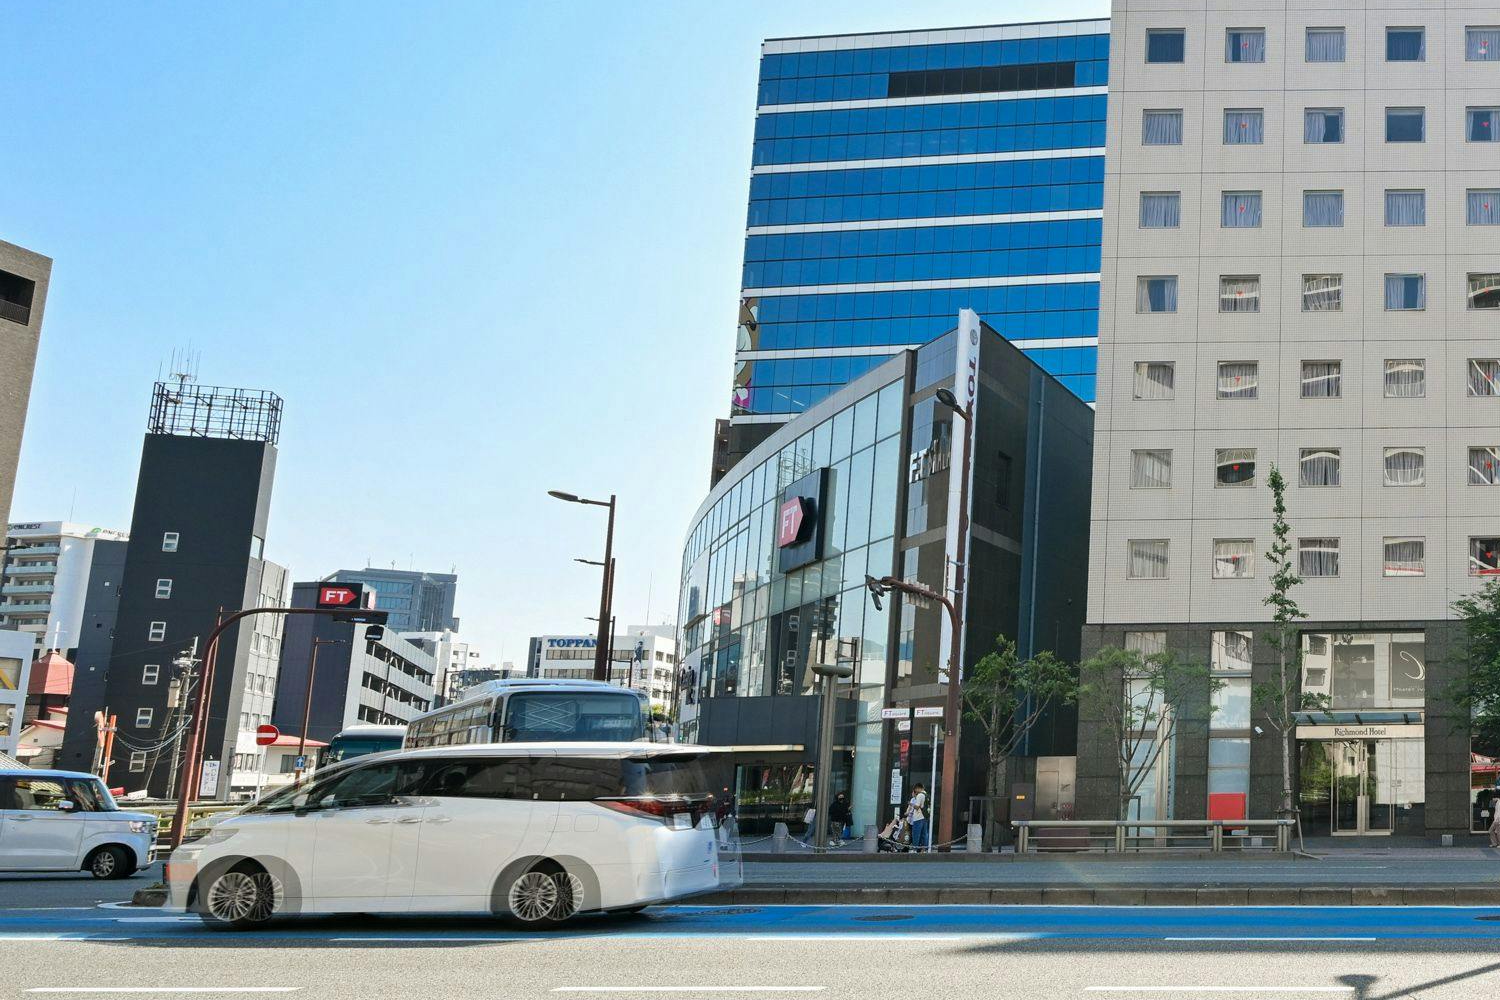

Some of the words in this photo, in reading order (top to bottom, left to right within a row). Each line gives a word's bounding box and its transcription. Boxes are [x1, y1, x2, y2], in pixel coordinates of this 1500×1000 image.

[782, 504, 798, 538] FT
[325, 590, 348, 602] FT
[1334, 727, 1368, 736] Richmond
[1369, 727, 1387, 736] Hotel
